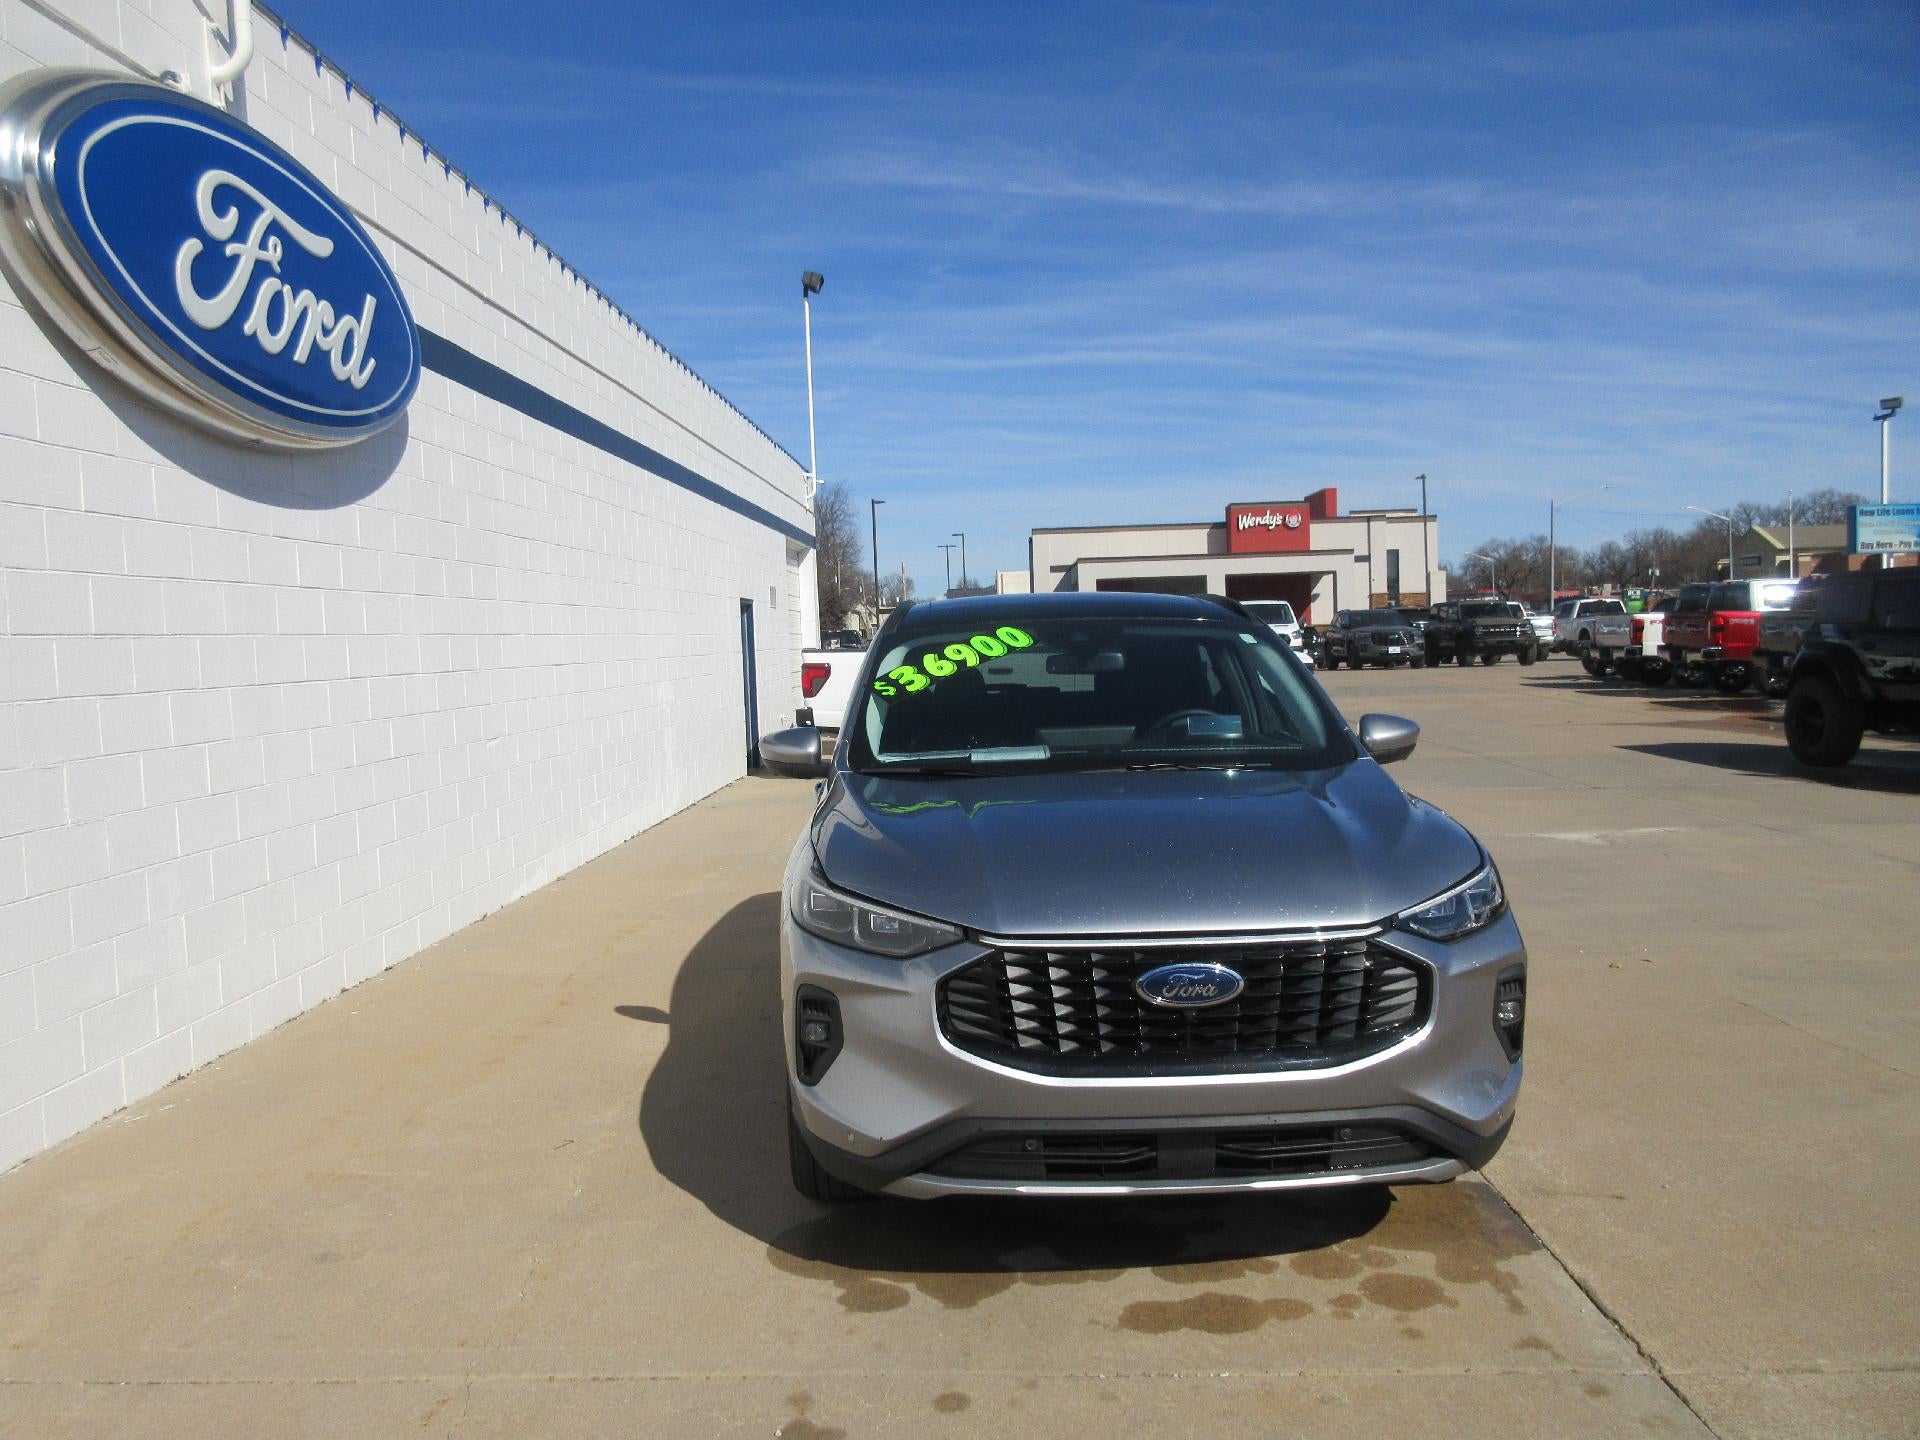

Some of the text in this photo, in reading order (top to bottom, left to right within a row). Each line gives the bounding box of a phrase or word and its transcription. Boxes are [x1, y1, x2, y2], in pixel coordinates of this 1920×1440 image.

[175, 168, 377, 391] Ford
[1238, 509, 1283, 530] Wendy's
[1860, 541, 1874, 550] Buy
[873, 626, 1034, 696] $36900
[1162, 973, 1218, 998] Ford
